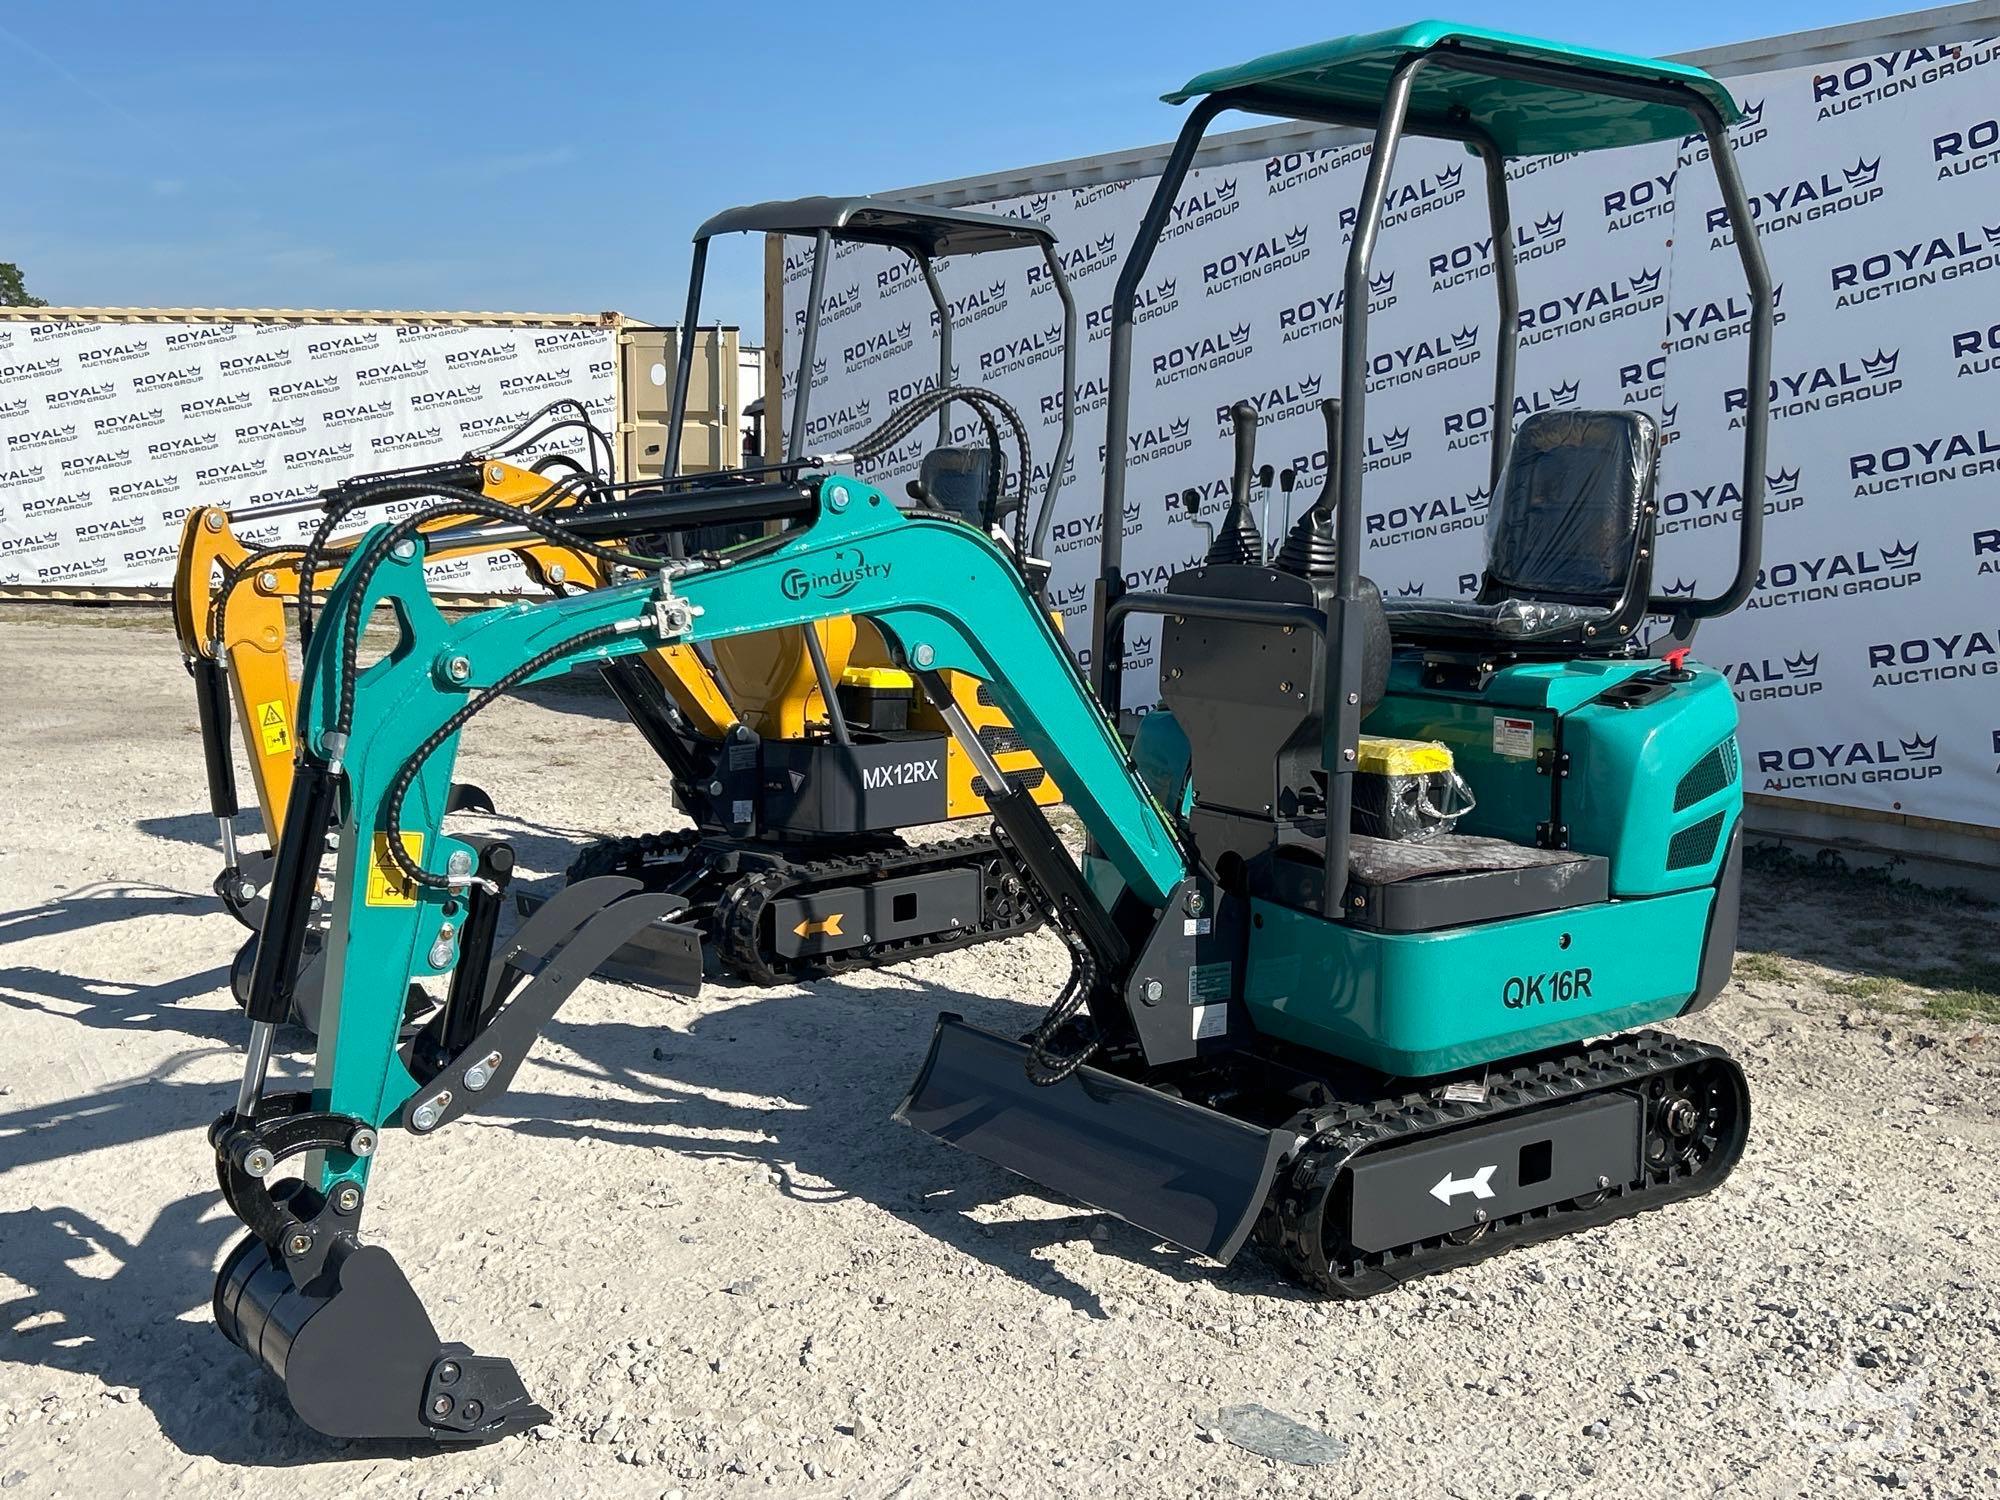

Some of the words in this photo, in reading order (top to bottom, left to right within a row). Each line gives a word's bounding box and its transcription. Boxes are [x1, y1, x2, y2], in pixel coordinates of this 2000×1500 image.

[1817, 73, 1919, 121] AUCTION
[1269, 161, 1330, 197] AUCTION
[1410, 188, 1465, 218] GROUP
[1807, 185, 1885, 219] GROUP
[1196, 200, 1239, 226] GROUP
[1078, 253, 1117, 276] GROUP
[1201, 236, 1286, 283] ROYAL
[1830, 230, 1983, 291] ROYAL
[1205, 265, 1262, 297] AUCTION
[1264, 247, 1311, 274] GROUP
[879, 274, 917, 300] AUCTION
[1835, 268, 1938, 309] AUCTION
[833, 300, 861, 320] GROUP
[974, 299, 1008, 320] GROUP
[1137, 299, 1178, 322] GROUP
[1514, 280, 1630, 332] ROYAL
[1282, 313, 1343, 344] AUCTION
[1518, 314, 1596, 349] AUCTION
[1599, 294, 1664, 323] GROUP
[165, 328, 221, 345] ROYAL
[168, 340, 206, 352] AUCTION
[207, 334, 237, 344] GROUP
[307, 336, 363, 353] ROYAL
[534, 330, 591, 347] ROYAL
[537, 342, 576, 355] AUCTION
[576, 336, 607, 347] GROUP
[79, 345, 134, 362] ROYAL
[310, 348, 348, 360] AUCTION
[349, 342, 380, 353] GROUP
[445, 346, 501, 363] ROYAL
[843, 329, 897, 364] ROYAL
[979, 333, 1044, 370] ROYAL
[1151, 333, 1231, 374] ROYAL
[81, 356, 119, 369] AUCTION
[120, 351, 150, 361] GROUP
[220, 353, 276, 370] ROYAL
[448, 358, 486, 371] AUCTION
[487, 353, 518, 363] GROUP
[846, 352, 882, 375] AUCTION
[883, 339, 913, 358] GROUP
[982, 357, 1026, 383] AUCTION
[1027, 343, 1063, 365] GROUP
[1426, 350, 1481, 375] GROUP
[32, 368, 63, 378] GROUP
[222, 365, 261, 377] AUCTION
[261, 359, 292, 369] GROUP
[356, 363, 412, 379] ROYAL
[1154, 360, 1208, 388] AUCTION
[1209, 345, 1253, 368] GROUP
[132, 370, 188, 386] ROYAL
[135, 381, 173, 394] AUCTION
[174, 376, 204, 386] GROUP
[359, 374, 397, 387] AUCTION
[398, 369, 428, 379] GROUP
[500, 372, 556, 389] ROYAL
[502, 384, 541, 396] AUCTION
[542, 378, 573, 388] GROUP
[45, 386, 101, 403] ROYAL
[269, 379, 324, 396] ROYAL
[271, 391, 309, 403] AUCTION
[310, 385, 341, 395] GROUP
[411, 388, 467, 405] ROYAL
[1825, 378, 1903, 407] GROUP
[48, 398, 86, 410] AUCTION
[86, 392, 117, 402] GROUP
[181, 395, 236, 412] ROYAL
[413, 400, 452, 412] AUCTION
[452, 394, 483, 404] GROUP
[1277, 397, 1324, 420] GROUP
[183, 407, 221, 419] AUCTION
[222, 402, 252, 412] GROUP
[322, 404, 378, 421] ROYAL
[325, 416, 363, 428] AUCTION
[364, 410, 394, 421] GROUP
[94, 412, 149, 429] ROYAL
[97, 424, 134, 436] AUCTION
[135, 418, 165, 428] GROUP
[235, 420, 291, 437] ROYAL
[459, 415, 516, 431] ROYAL
[805, 405, 857, 437] ROYAL
[7, 428, 62, 445] ROYAL
[238, 432, 276, 444] AUCTION
[276, 427, 307, 437] GROUP
[371, 430, 427, 447] ROYAL
[462, 426, 500, 439] AUCTION
[808, 427, 842, 448] AUCTION
[843, 416, 871, 434] GROUP
[10, 440, 47, 452] AUCTION
[48, 434, 78, 445] GROUP
[148, 437, 203, 453] ROYAL
[150, 448, 188, 461] AUCTION
[189, 443, 219, 453] GROUP
[373, 442, 412, 454] AUCTION
[412, 437, 443, 447] GROUP
[1151, 438, 1192, 459] GROUP
[61, 453, 116, 470] ROYAL
[283, 446, 339, 463] ROYAL
[286, 458, 324, 470] AUCTION
[325, 453, 355, 463] GROUP
[853, 447, 908, 478] ROYAL
[1849, 428, 1999, 479] ROYAL
[64, 465, 101, 477] AUCTION
[102, 459, 132, 469] GROUP
[196, 463, 251, 479] ROYAL
[15, 475, 45, 485] GROUP
[198, 474, 236, 486] AUCTION
[237, 469, 267, 479] GROUP
[1854, 465, 1958, 498] AUCTION
[109, 479, 164, 495] ROYAL
[112, 490, 149, 502] AUCTION
[150, 485, 180, 495] GROUP
[250, 487, 305, 504] ROYAL
[22, 495, 77, 511] ROYAL
[25, 506, 62, 518] AUCTION
[63, 501, 93, 511] GROUP
[1367, 495, 1466, 534] ROYAL
[75, 519, 130, 536] ROYAL
[339, 520, 370, 530] GROUP
[78, 531, 116, 543] AUCTION
[116, 526, 146, 536] GROUP
[1055, 533, 1102, 554] AUCTION
[1371, 524, 1437, 549] AUCTION
[30, 541, 60, 551] GROUP
[123, 545, 178, 562] ROYAL
[38, 561, 92, 577] ROYAL
[126, 557, 164, 569] AUCTION
[40, 572, 78, 584] AUCTION
[78, 567, 108, 577] GROUP
[442, 571, 472, 581] GROUP
[1745, 583, 1840, 610] AUCTION
[1844, 571, 1923, 595] GROUP
[1873, 662, 1978, 687] AUCTION
[1750, 680, 1823, 701] GROUP
[1758, 739, 1900, 772] ROYAL
[863, 760, 938, 789] MX12RX
[1763, 770, 1858, 790] AUCTION
[1862, 764, 1942, 783] GROUP
[1503, 968, 1592, 1009] QK16R
